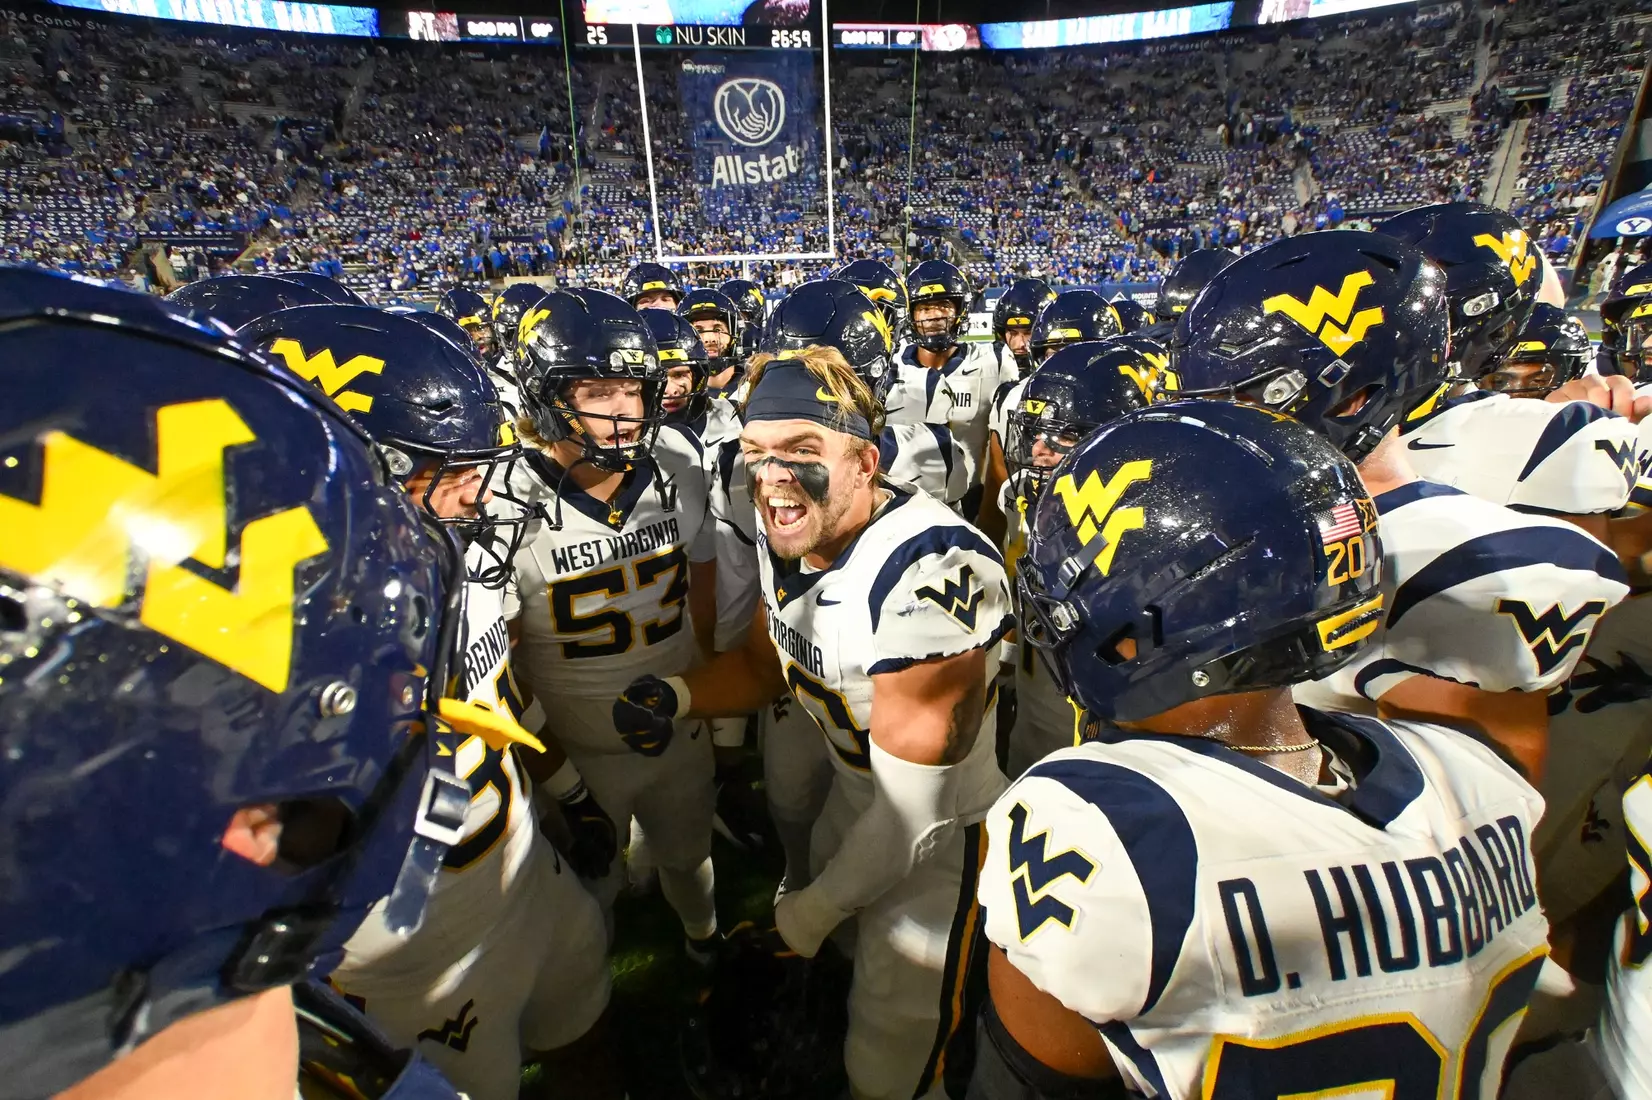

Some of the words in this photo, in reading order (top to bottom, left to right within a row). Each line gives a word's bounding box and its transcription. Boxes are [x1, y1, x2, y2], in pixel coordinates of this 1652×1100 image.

[33, 13, 81, 28] Conch
[587, 26, 608, 45] 25
[675, 26, 702, 46] NU
[707, 26, 746, 46] SKIN
[771, 29, 811, 48] 26:59
[551, 539, 604, 575] WEST
[606, 517, 680, 561] VIRGINIA
[1323, 535, 1366, 587] 20
[548, 544, 690, 660] 53
[464, 614, 508, 695] RGINIA
[1218, 877, 1300, 998] D.
[1303, 814, 1537, 981] HUBBARD
